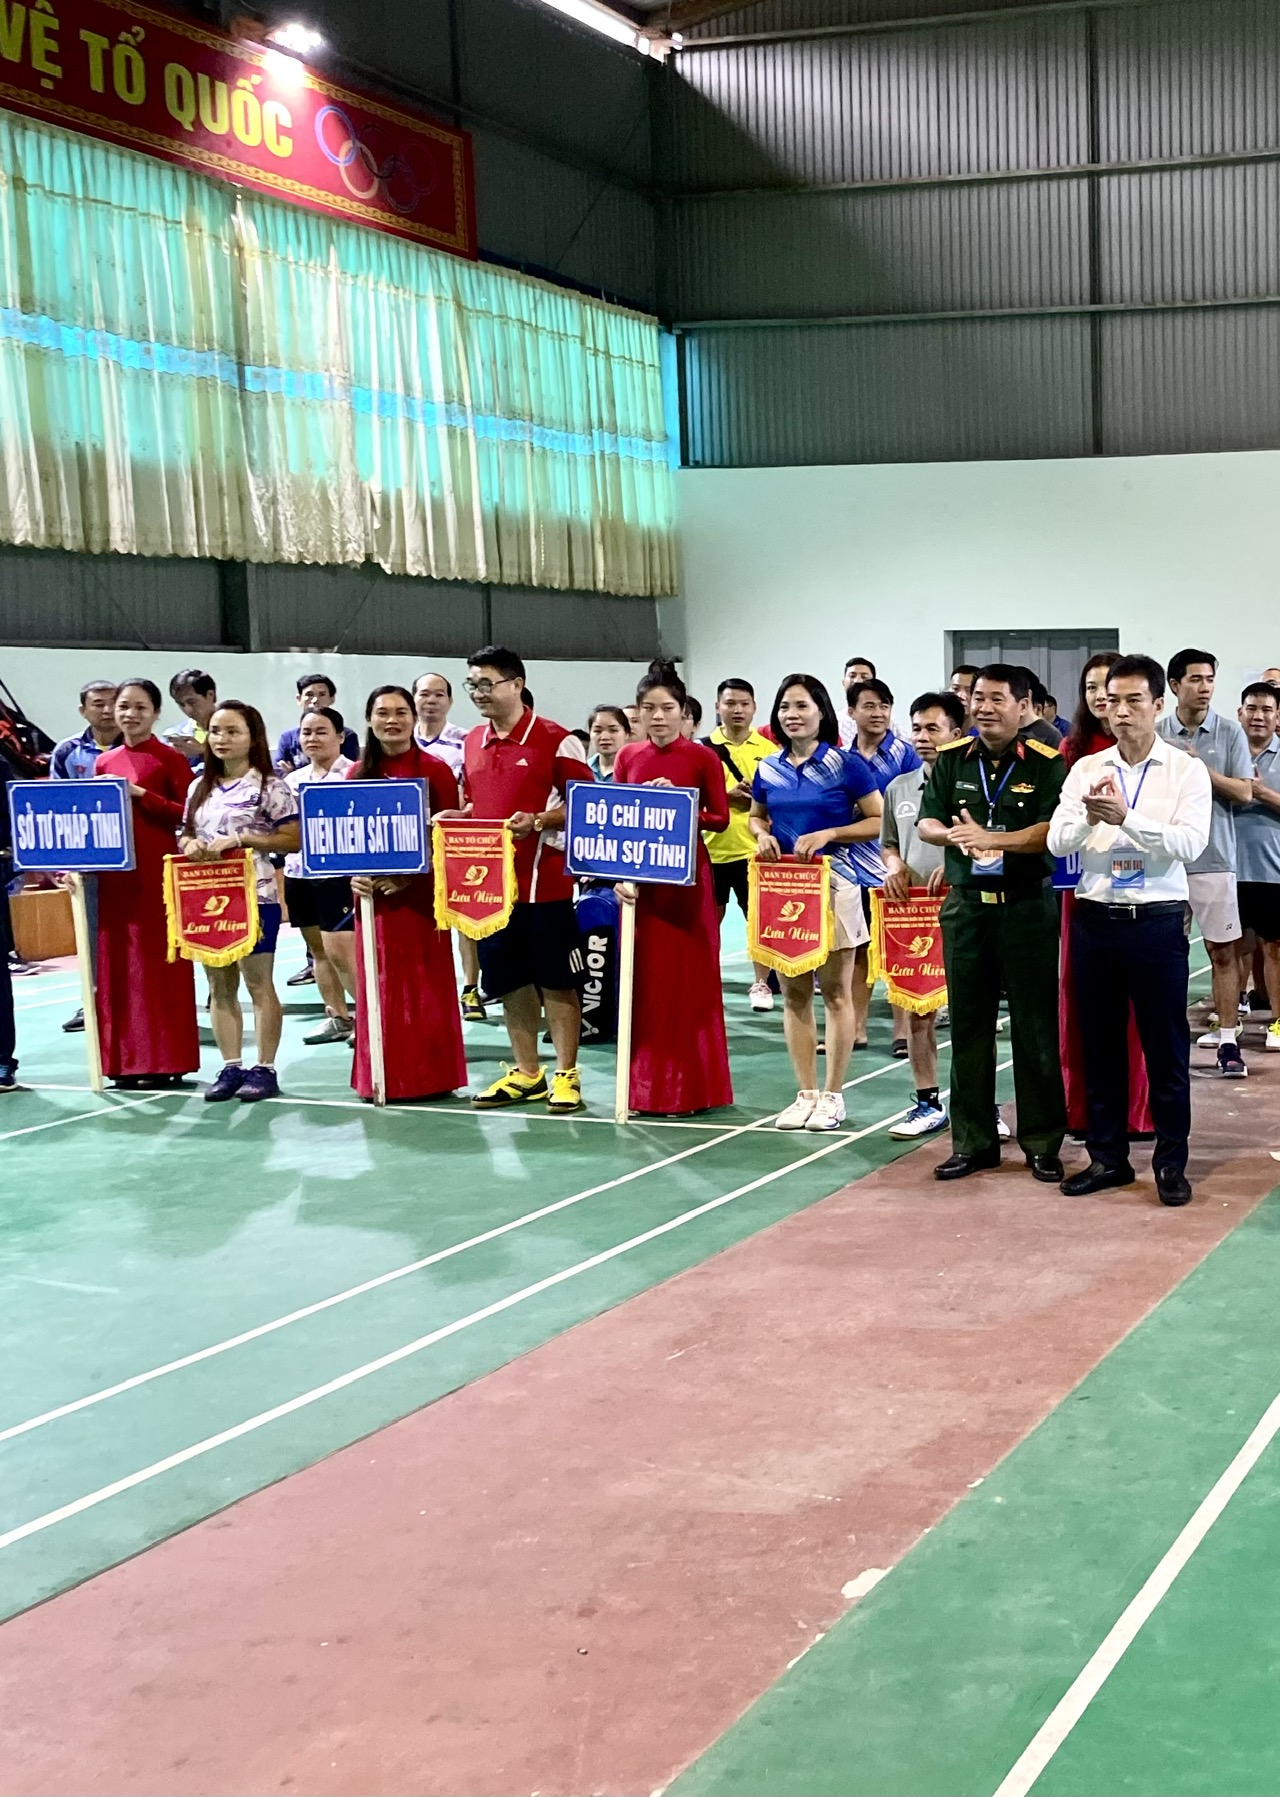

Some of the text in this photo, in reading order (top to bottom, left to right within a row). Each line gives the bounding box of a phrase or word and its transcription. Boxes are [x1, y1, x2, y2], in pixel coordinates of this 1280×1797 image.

[80, 25, 146, 105] TỔ
[164, 62, 293, 158] QUỐC
[17, 800, 121, 850] SỞ TƯ PHÁP TỈNH
[307, 800, 418, 864] VIỆN KIỂM SÁT TỈNH
[586, 799, 676, 831] BỘ CHỈ HUY
[574, 834, 686, 869] QUÂN SỰ TỈNH
[582, 935, 608, 1014] VICTOR
